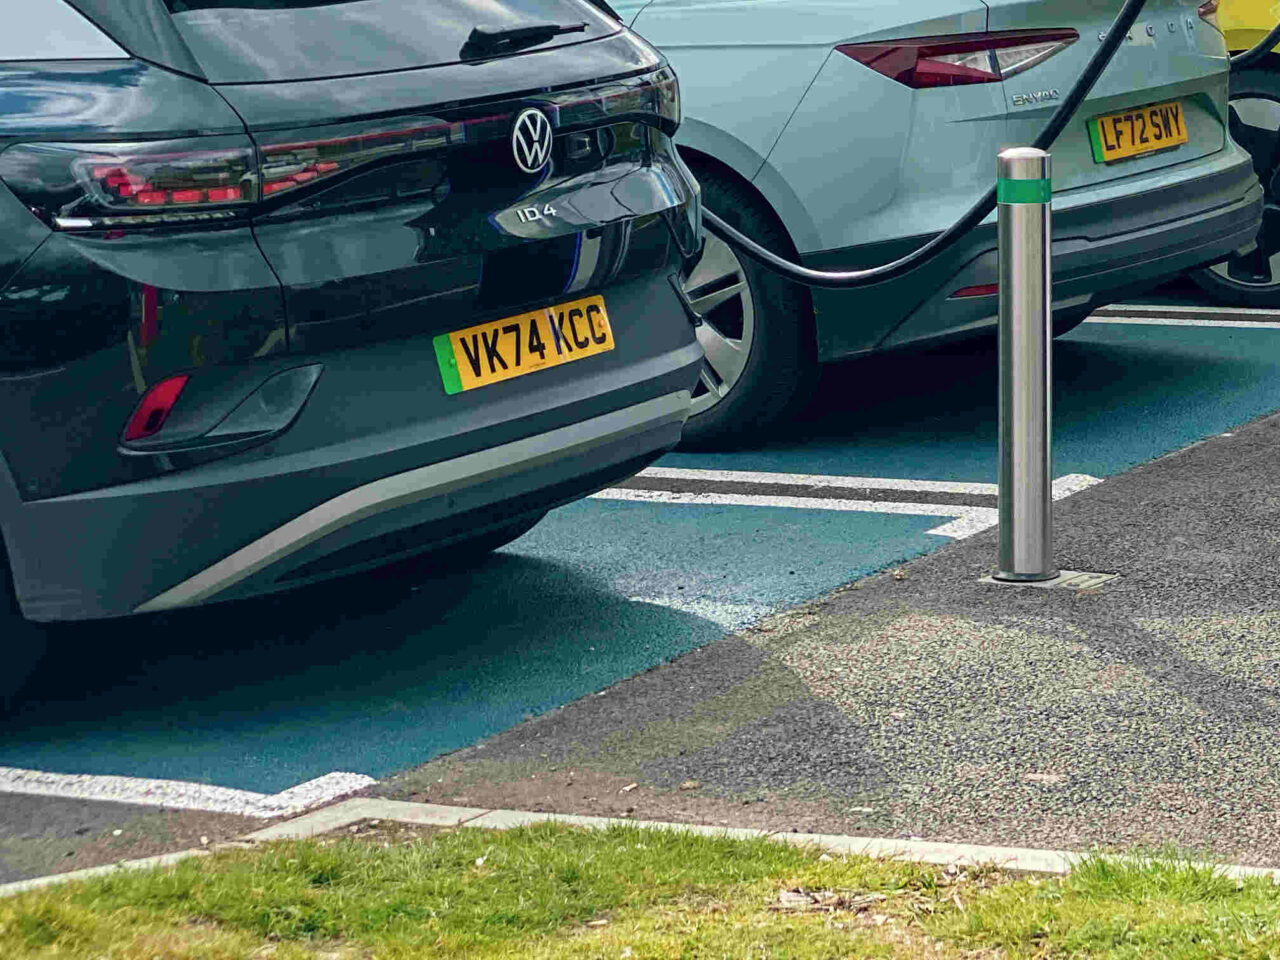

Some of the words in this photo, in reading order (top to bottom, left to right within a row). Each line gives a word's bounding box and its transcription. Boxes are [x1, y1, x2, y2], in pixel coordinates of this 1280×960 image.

[1099, 114, 1149, 152] LF72
[1149, 104, 1182, 141] SWY
[459, 318, 546, 378] VK74
[549, 304, 607, 355] KCC
